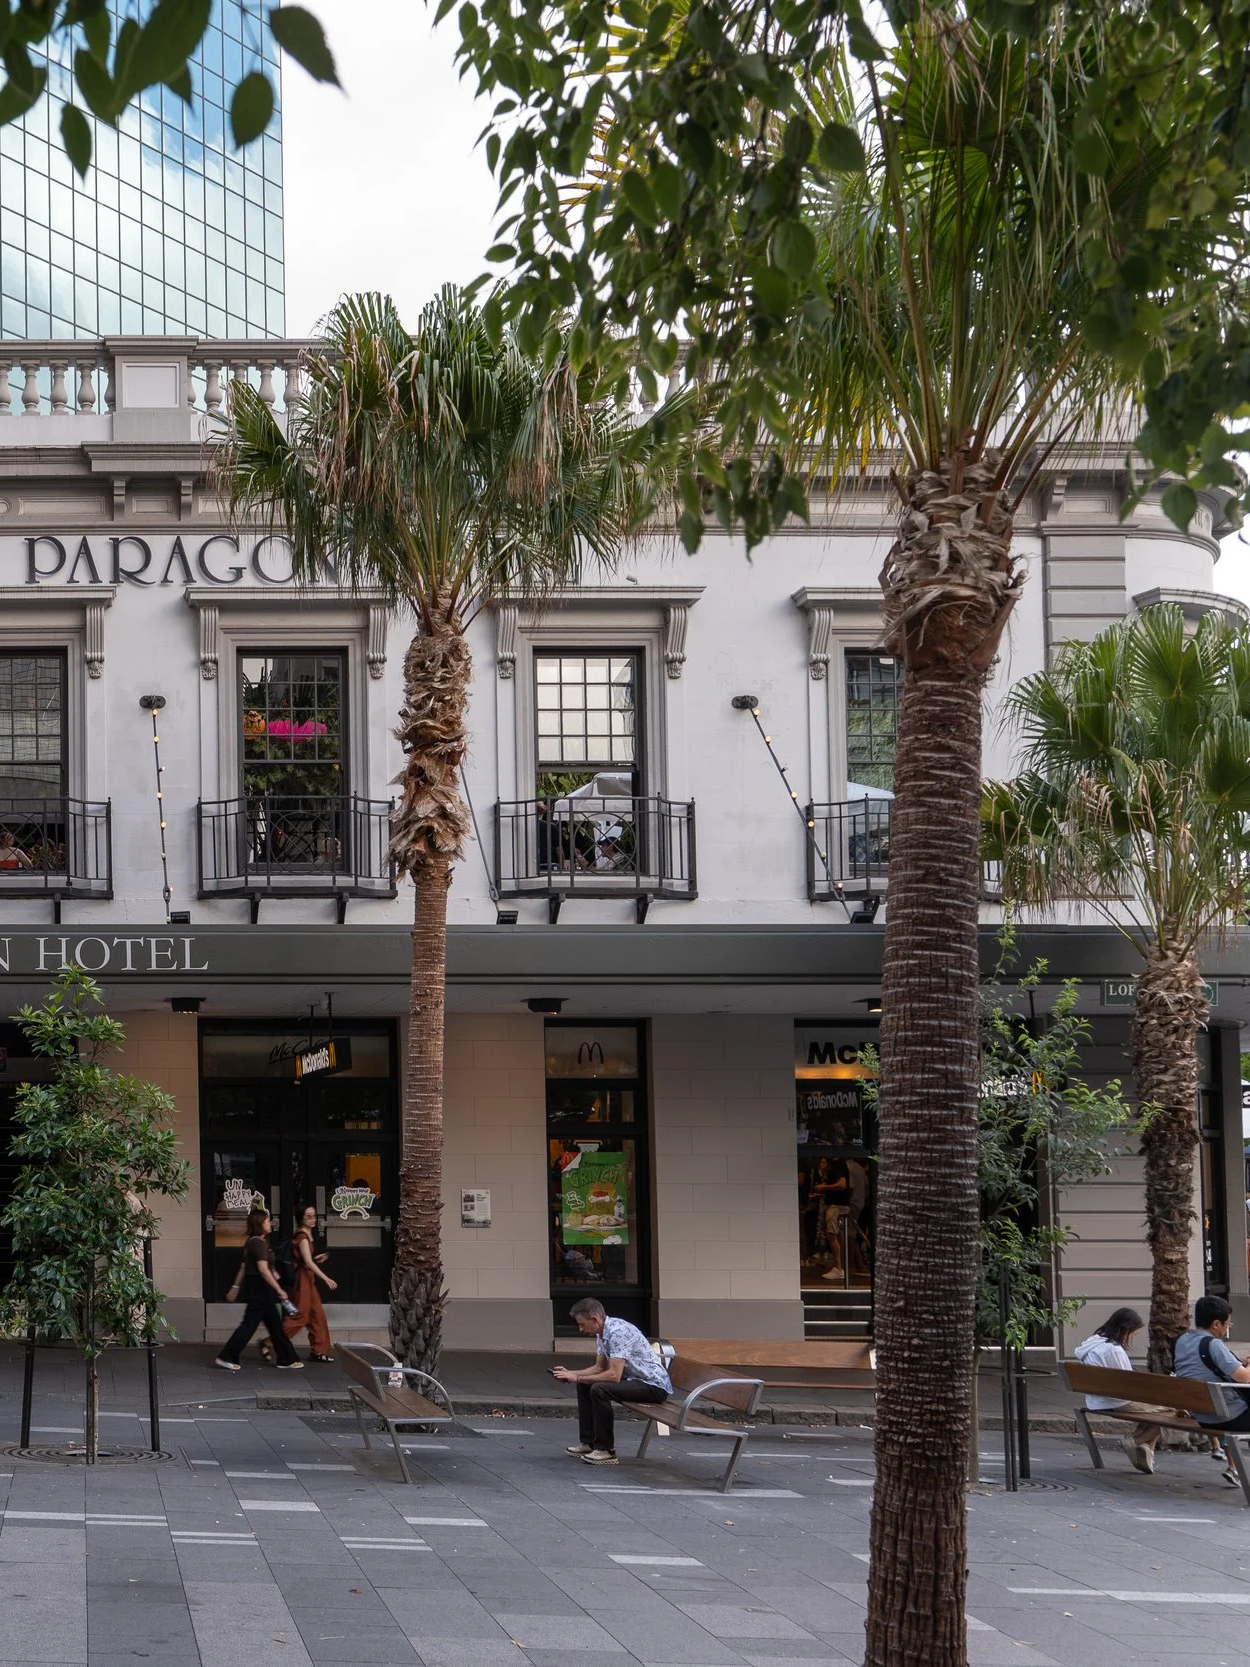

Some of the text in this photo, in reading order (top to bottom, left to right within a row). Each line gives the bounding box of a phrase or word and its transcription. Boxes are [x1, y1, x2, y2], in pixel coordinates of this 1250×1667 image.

[35, 937, 209, 972] HOTEL
[1109, 984, 1136, 996] LOF
[224, 1190, 251, 1201] HAPPY
[227, 1200, 250, 1208] MEAL
[333, 1194, 374, 1210] GRINCH
